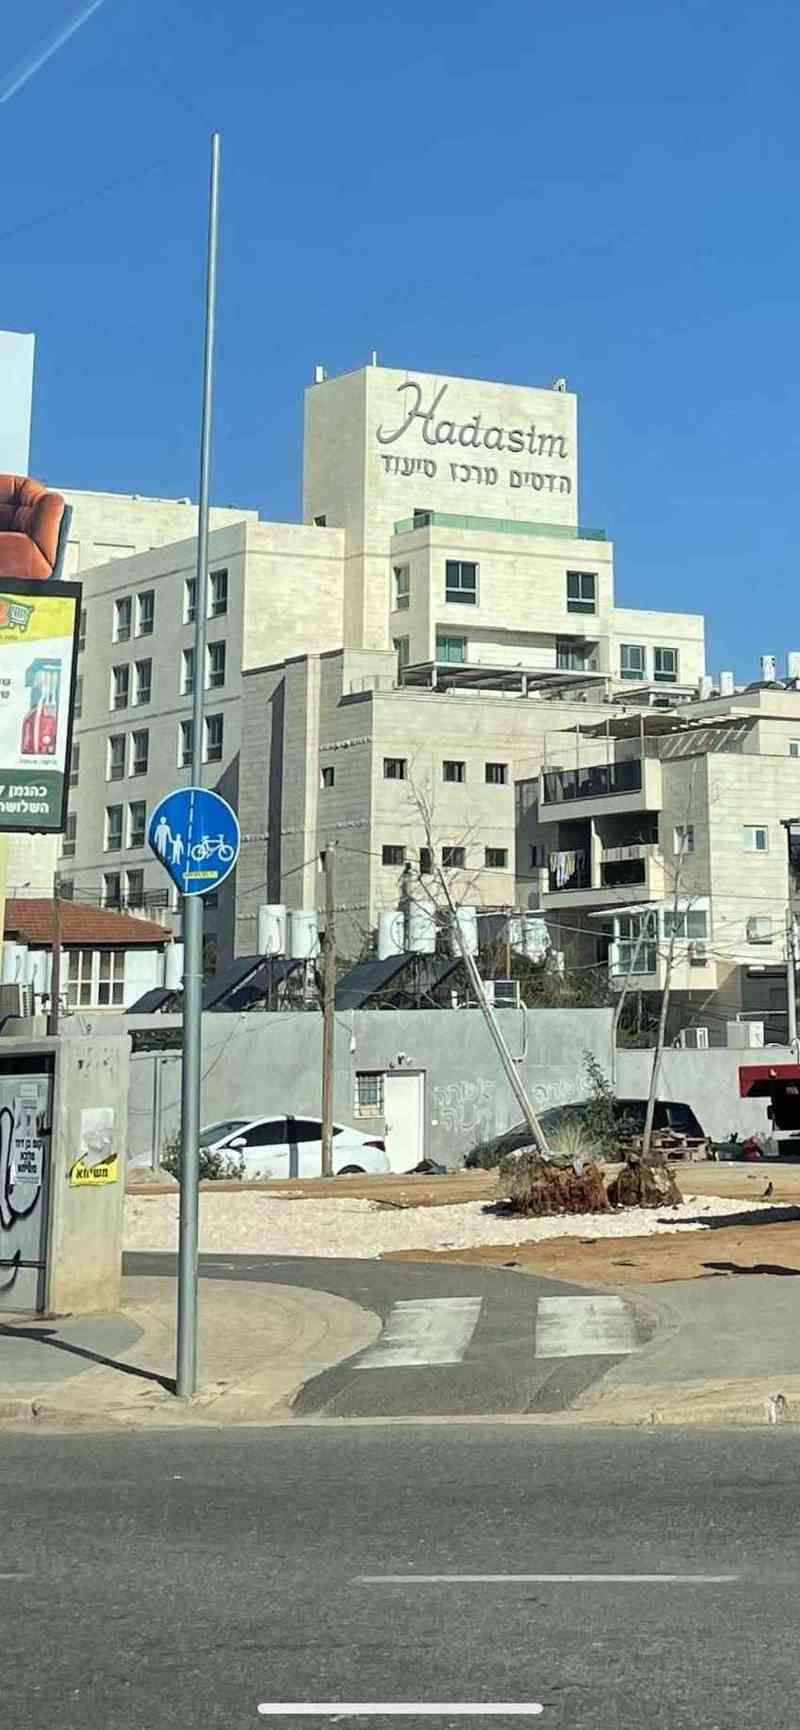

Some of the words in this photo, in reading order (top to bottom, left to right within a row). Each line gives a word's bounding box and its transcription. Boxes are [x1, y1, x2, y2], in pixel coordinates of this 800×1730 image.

[376, 381, 568, 459] Hadasim
[381, 454, 437, 478] סיעוד
[450, 461, 499, 485] מרכז
[509, 469, 573, 495] הדסים
[8, 785, 48, 798] כהנמן
